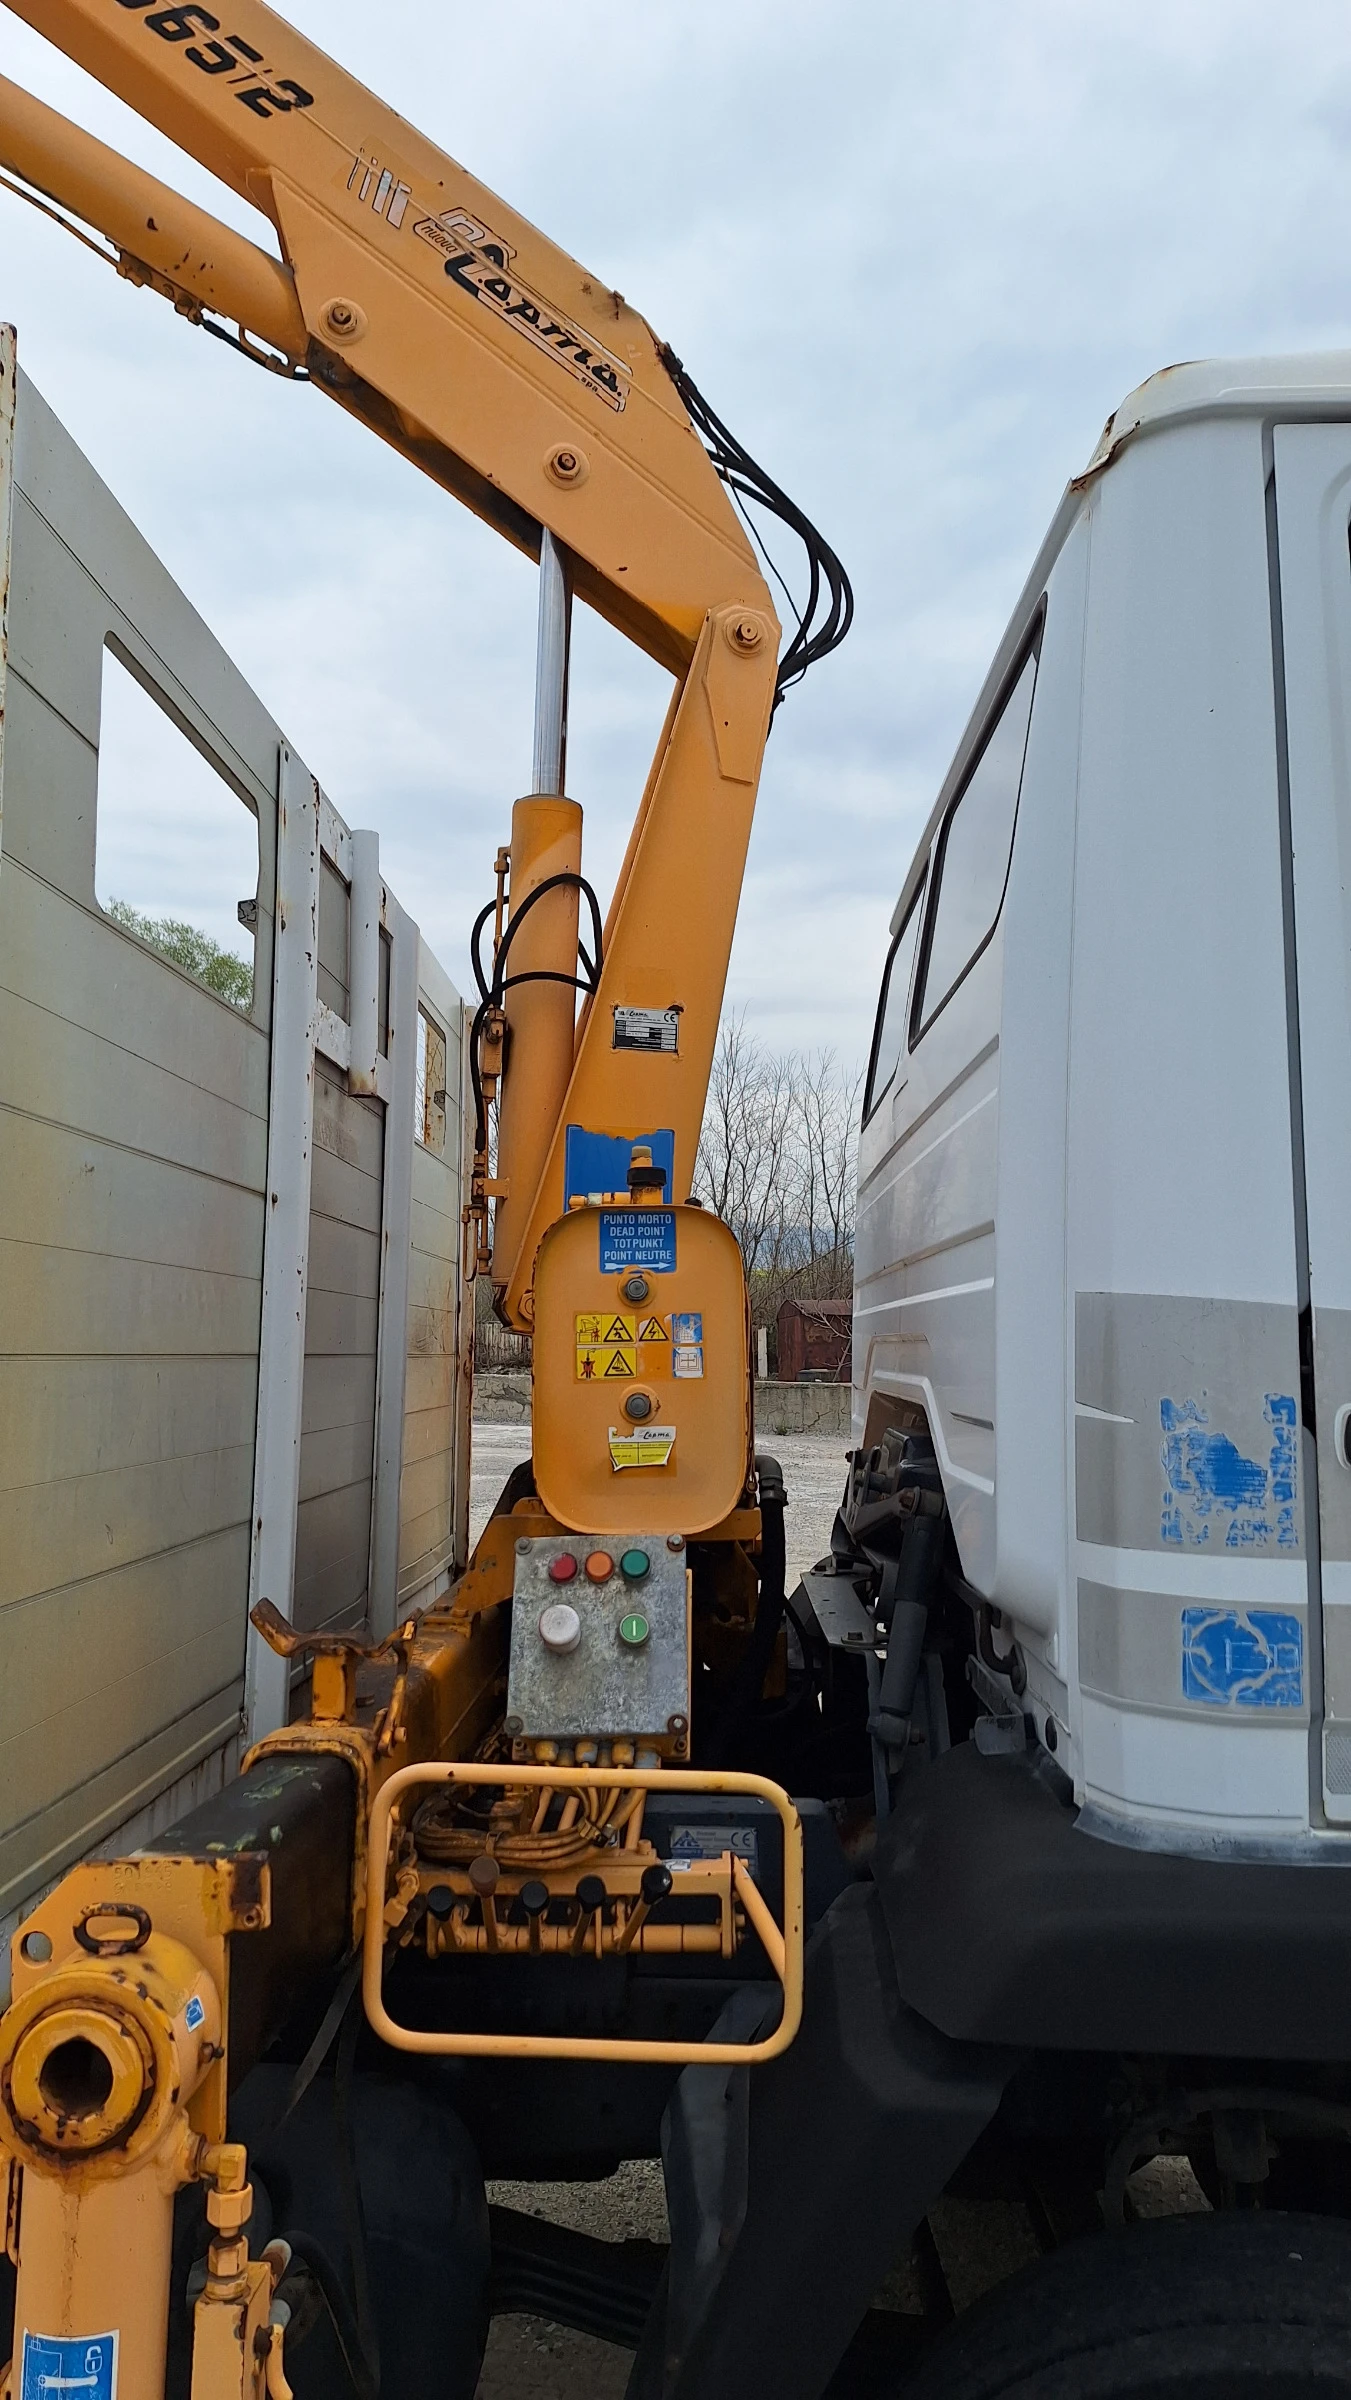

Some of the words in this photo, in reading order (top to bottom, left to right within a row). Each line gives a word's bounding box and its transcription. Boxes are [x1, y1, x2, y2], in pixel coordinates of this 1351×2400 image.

[420, 225, 458, 254] nuova
[580, 376, 599, 393] spa
[603, 1214, 635, 1224] PUNTO
[637, 1214, 672, 1224] MORTO
[609, 1226, 635, 1237] DEAD
[637, 1226, 666, 1236] POINT
[604, 1250, 633, 1260] POINT
[635, 1250, 673, 1260] NEUTRE
[730, 1831, 752, 1848] CE
